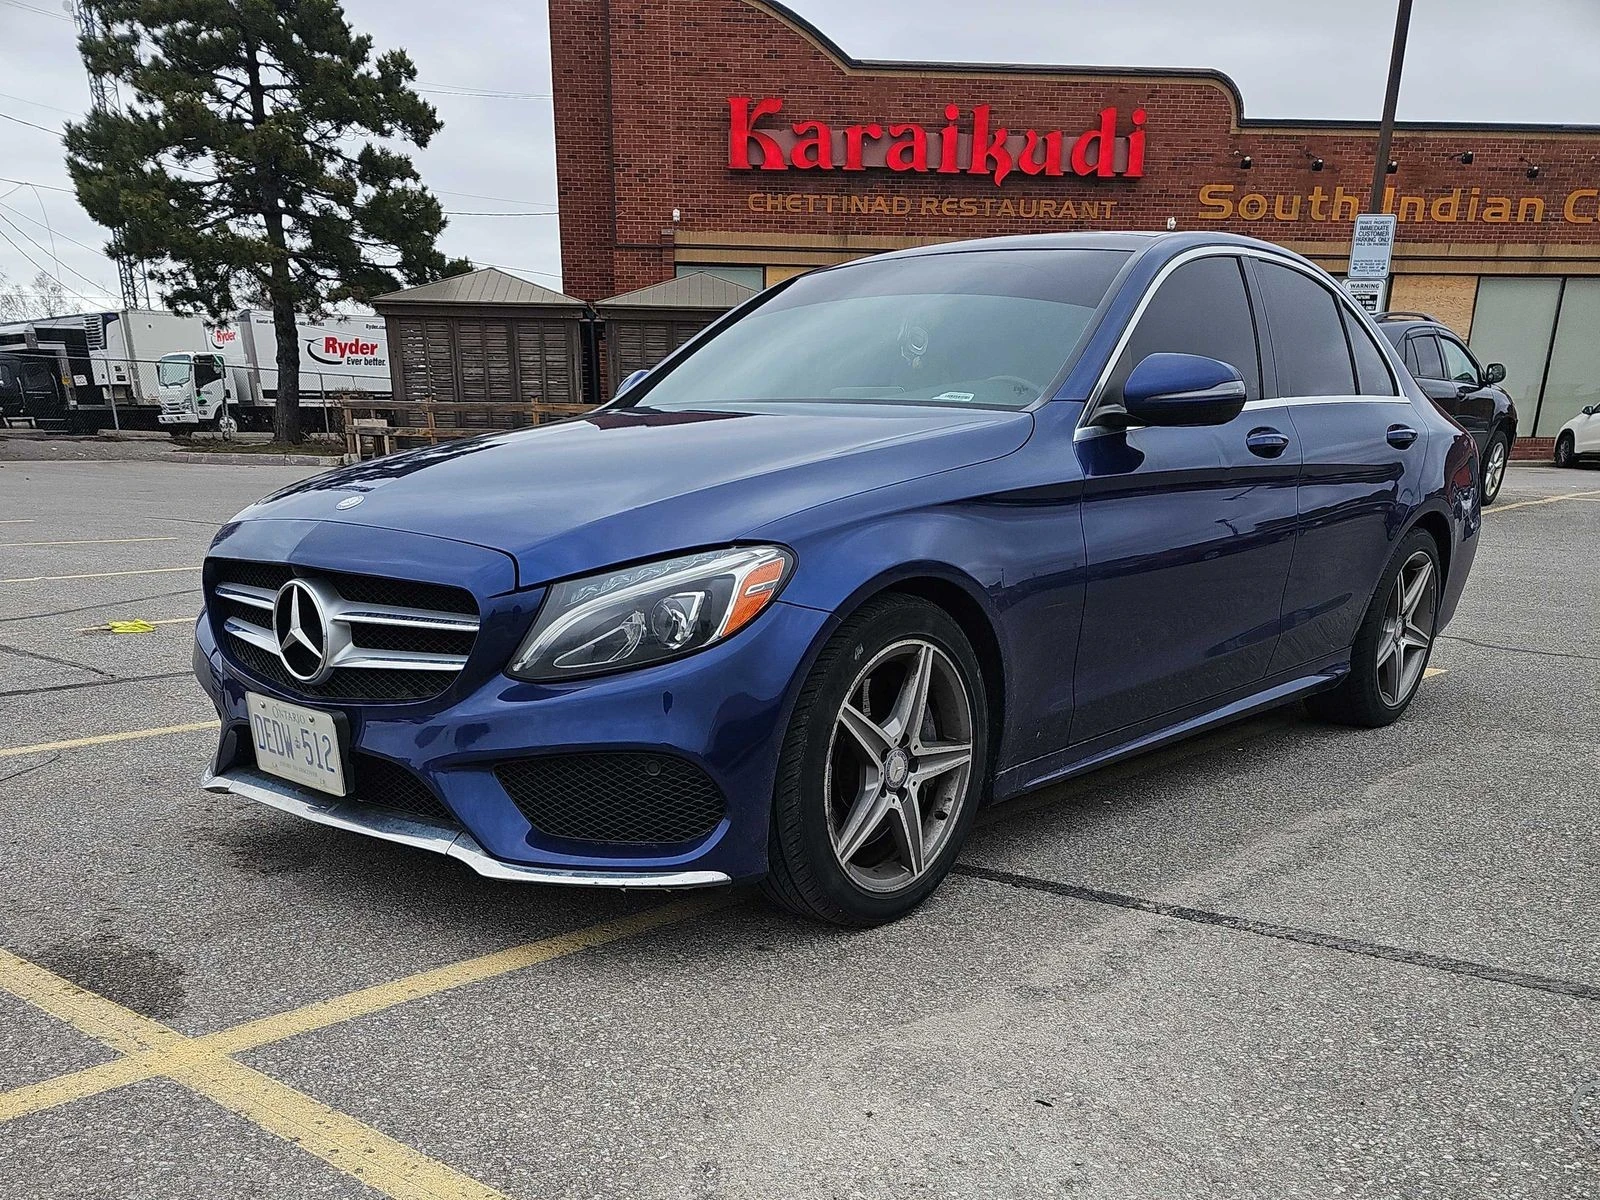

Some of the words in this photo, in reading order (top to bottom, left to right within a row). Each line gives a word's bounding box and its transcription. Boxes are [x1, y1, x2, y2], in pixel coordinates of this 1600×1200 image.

[727, 97, 1146, 187] Karaikudi
[747, 192, 912, 216] CHETTINAD
[919, 197, 1119, 220] RESTAURANT
[1199, 184, 1359, 221] South
[1382, 186, 1545, 223] Indian
[1563, 189, 1600, 224] C
[216, 330, 236, 344] Ryder
[324, 336, 379, 358] Ryder
[346, 356, 364, 366] Ever
[300, 727, 336, 774] 512
